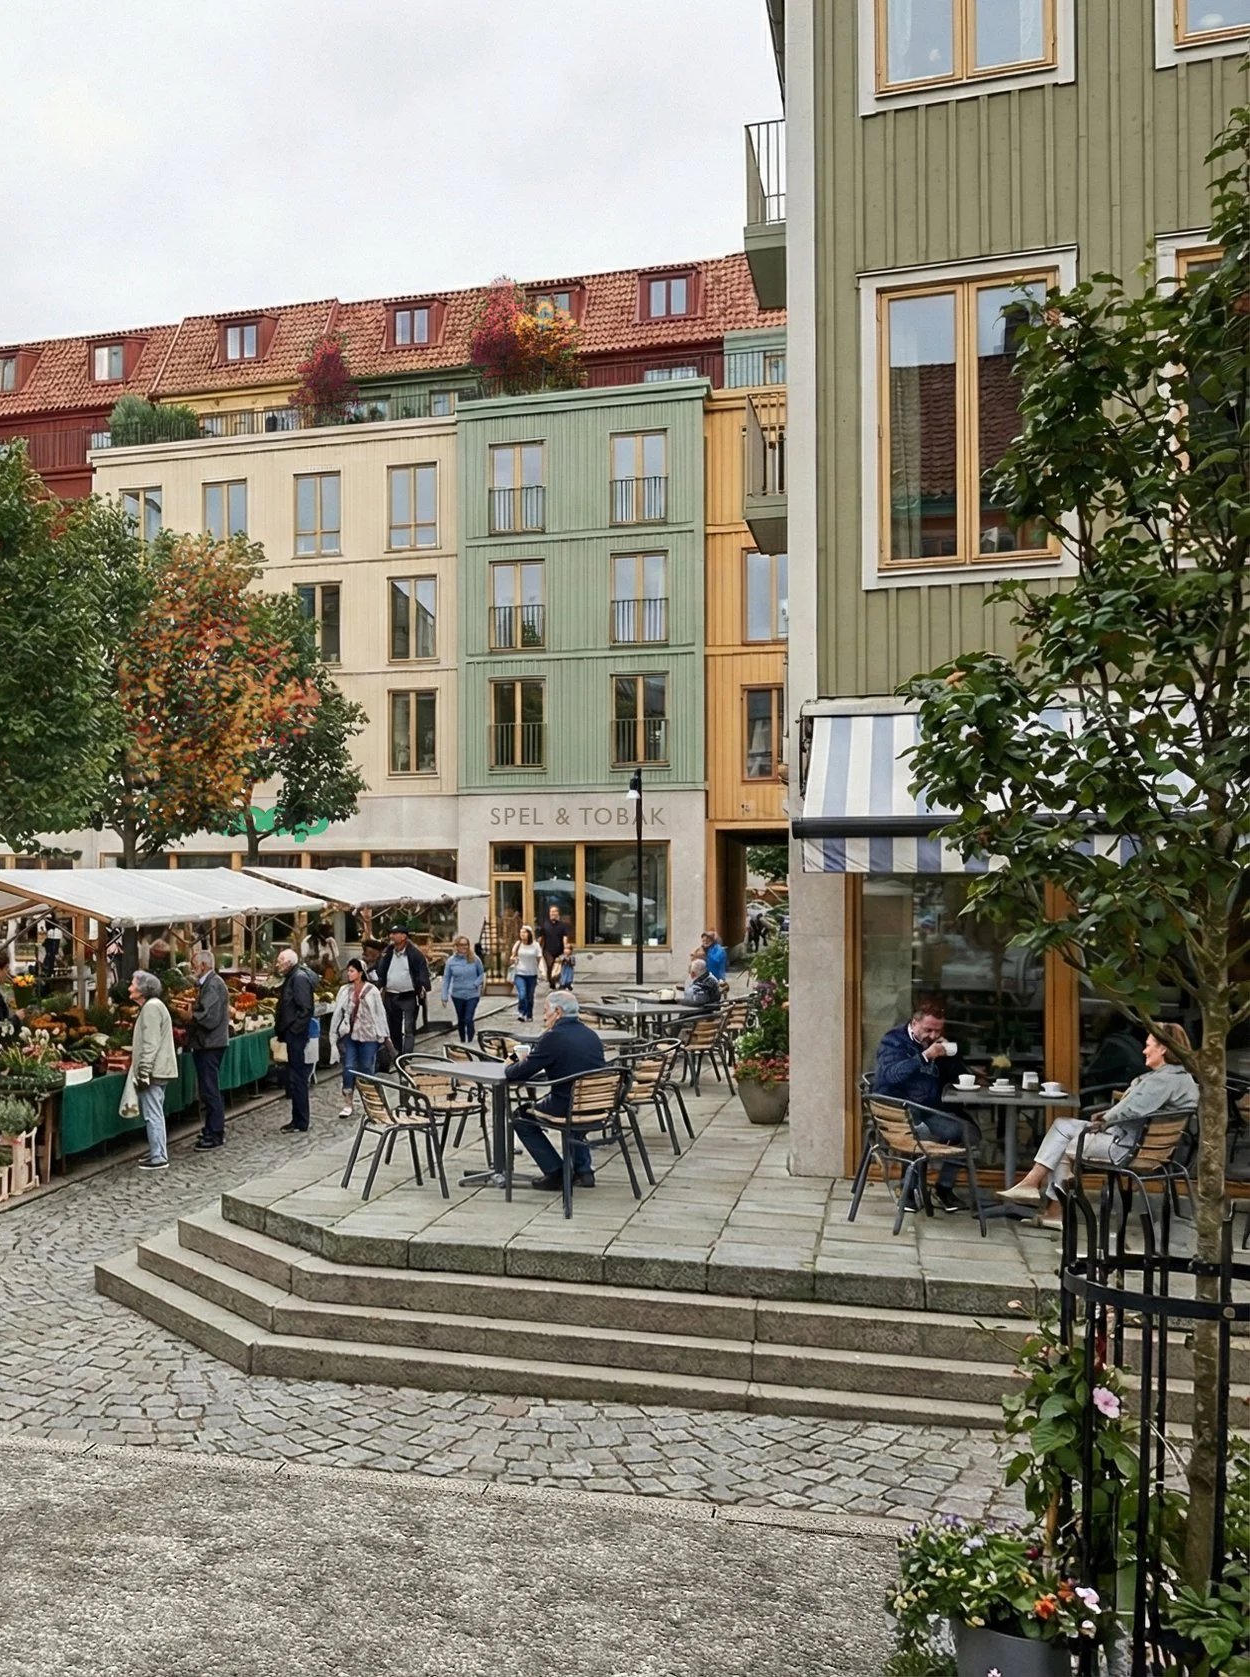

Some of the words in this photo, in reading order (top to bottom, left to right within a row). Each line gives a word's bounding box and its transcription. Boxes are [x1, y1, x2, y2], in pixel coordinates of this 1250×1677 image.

[490, 807, 544, 826] SPEL
[555, 807, 571, 826] &
[579, 807, 666, 826] TOBAK
